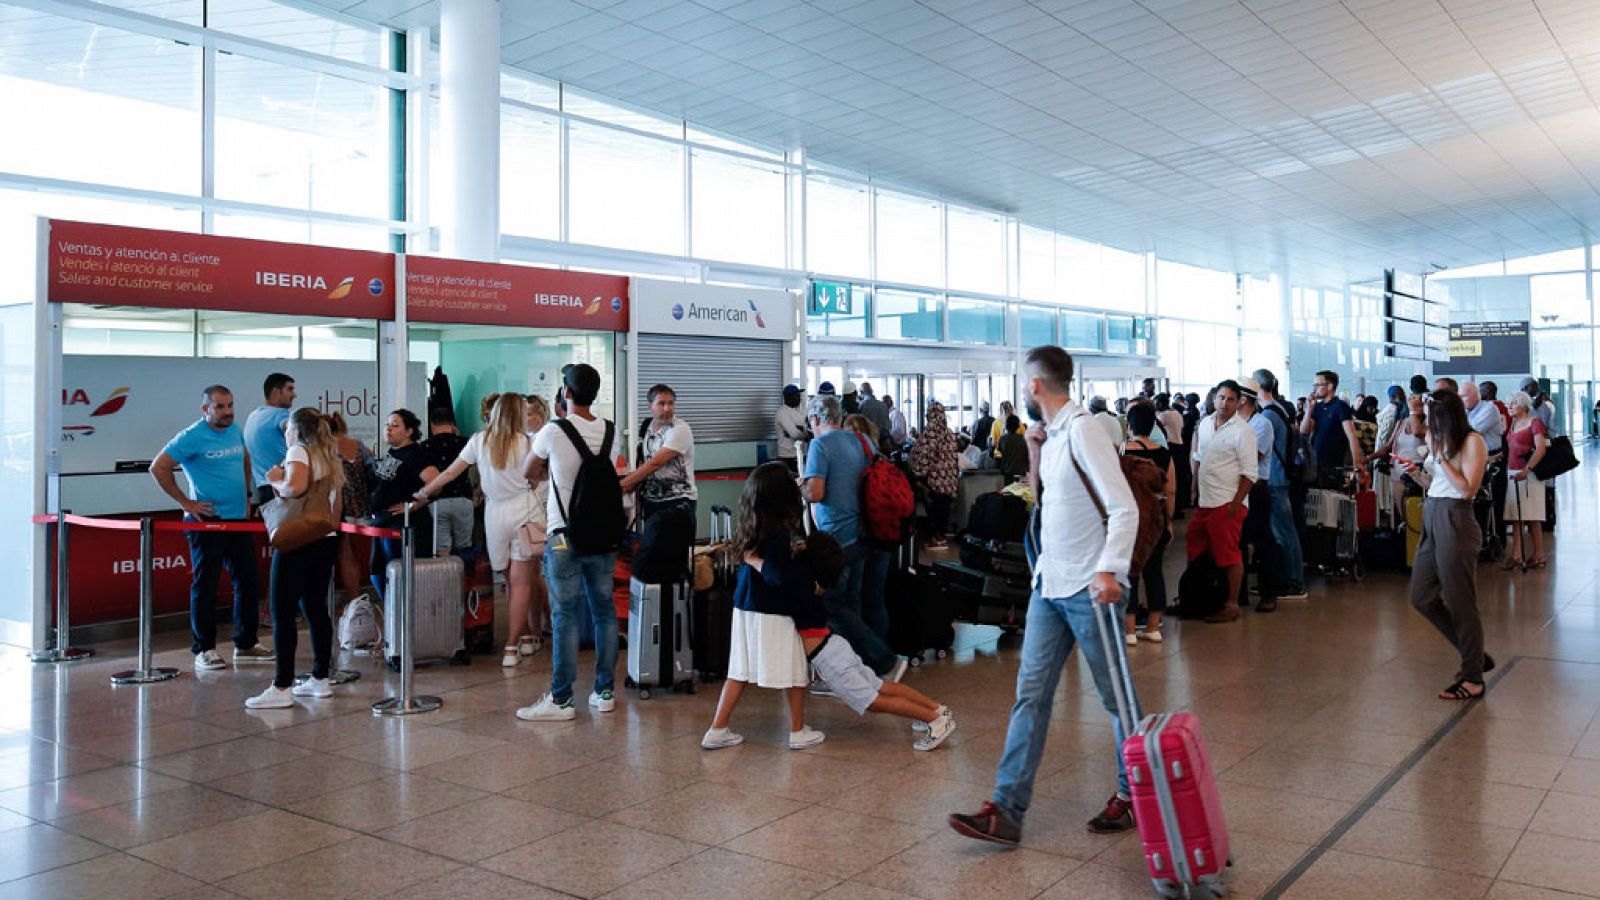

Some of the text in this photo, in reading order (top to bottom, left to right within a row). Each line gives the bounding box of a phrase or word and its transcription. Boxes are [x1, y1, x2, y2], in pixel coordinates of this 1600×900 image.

[58, 241, 102, 256] Ventas
[105, 248, 113, 258] y
[115, 246, 168, 260] atención
[182, 252, 221, 266] cliente
[58, 256, 103, 271] Vendes
[110, 260, 155, 274] atenció
[157, 263, 167, 275] al
[169, 265, 200, 278] client
[58, 271, 214, 293] Sales and customer service
[255, 271, 328, 290] IBERIA
[534, 293, 584, 308] IBERIA
[688, 302, 748, 323] American
